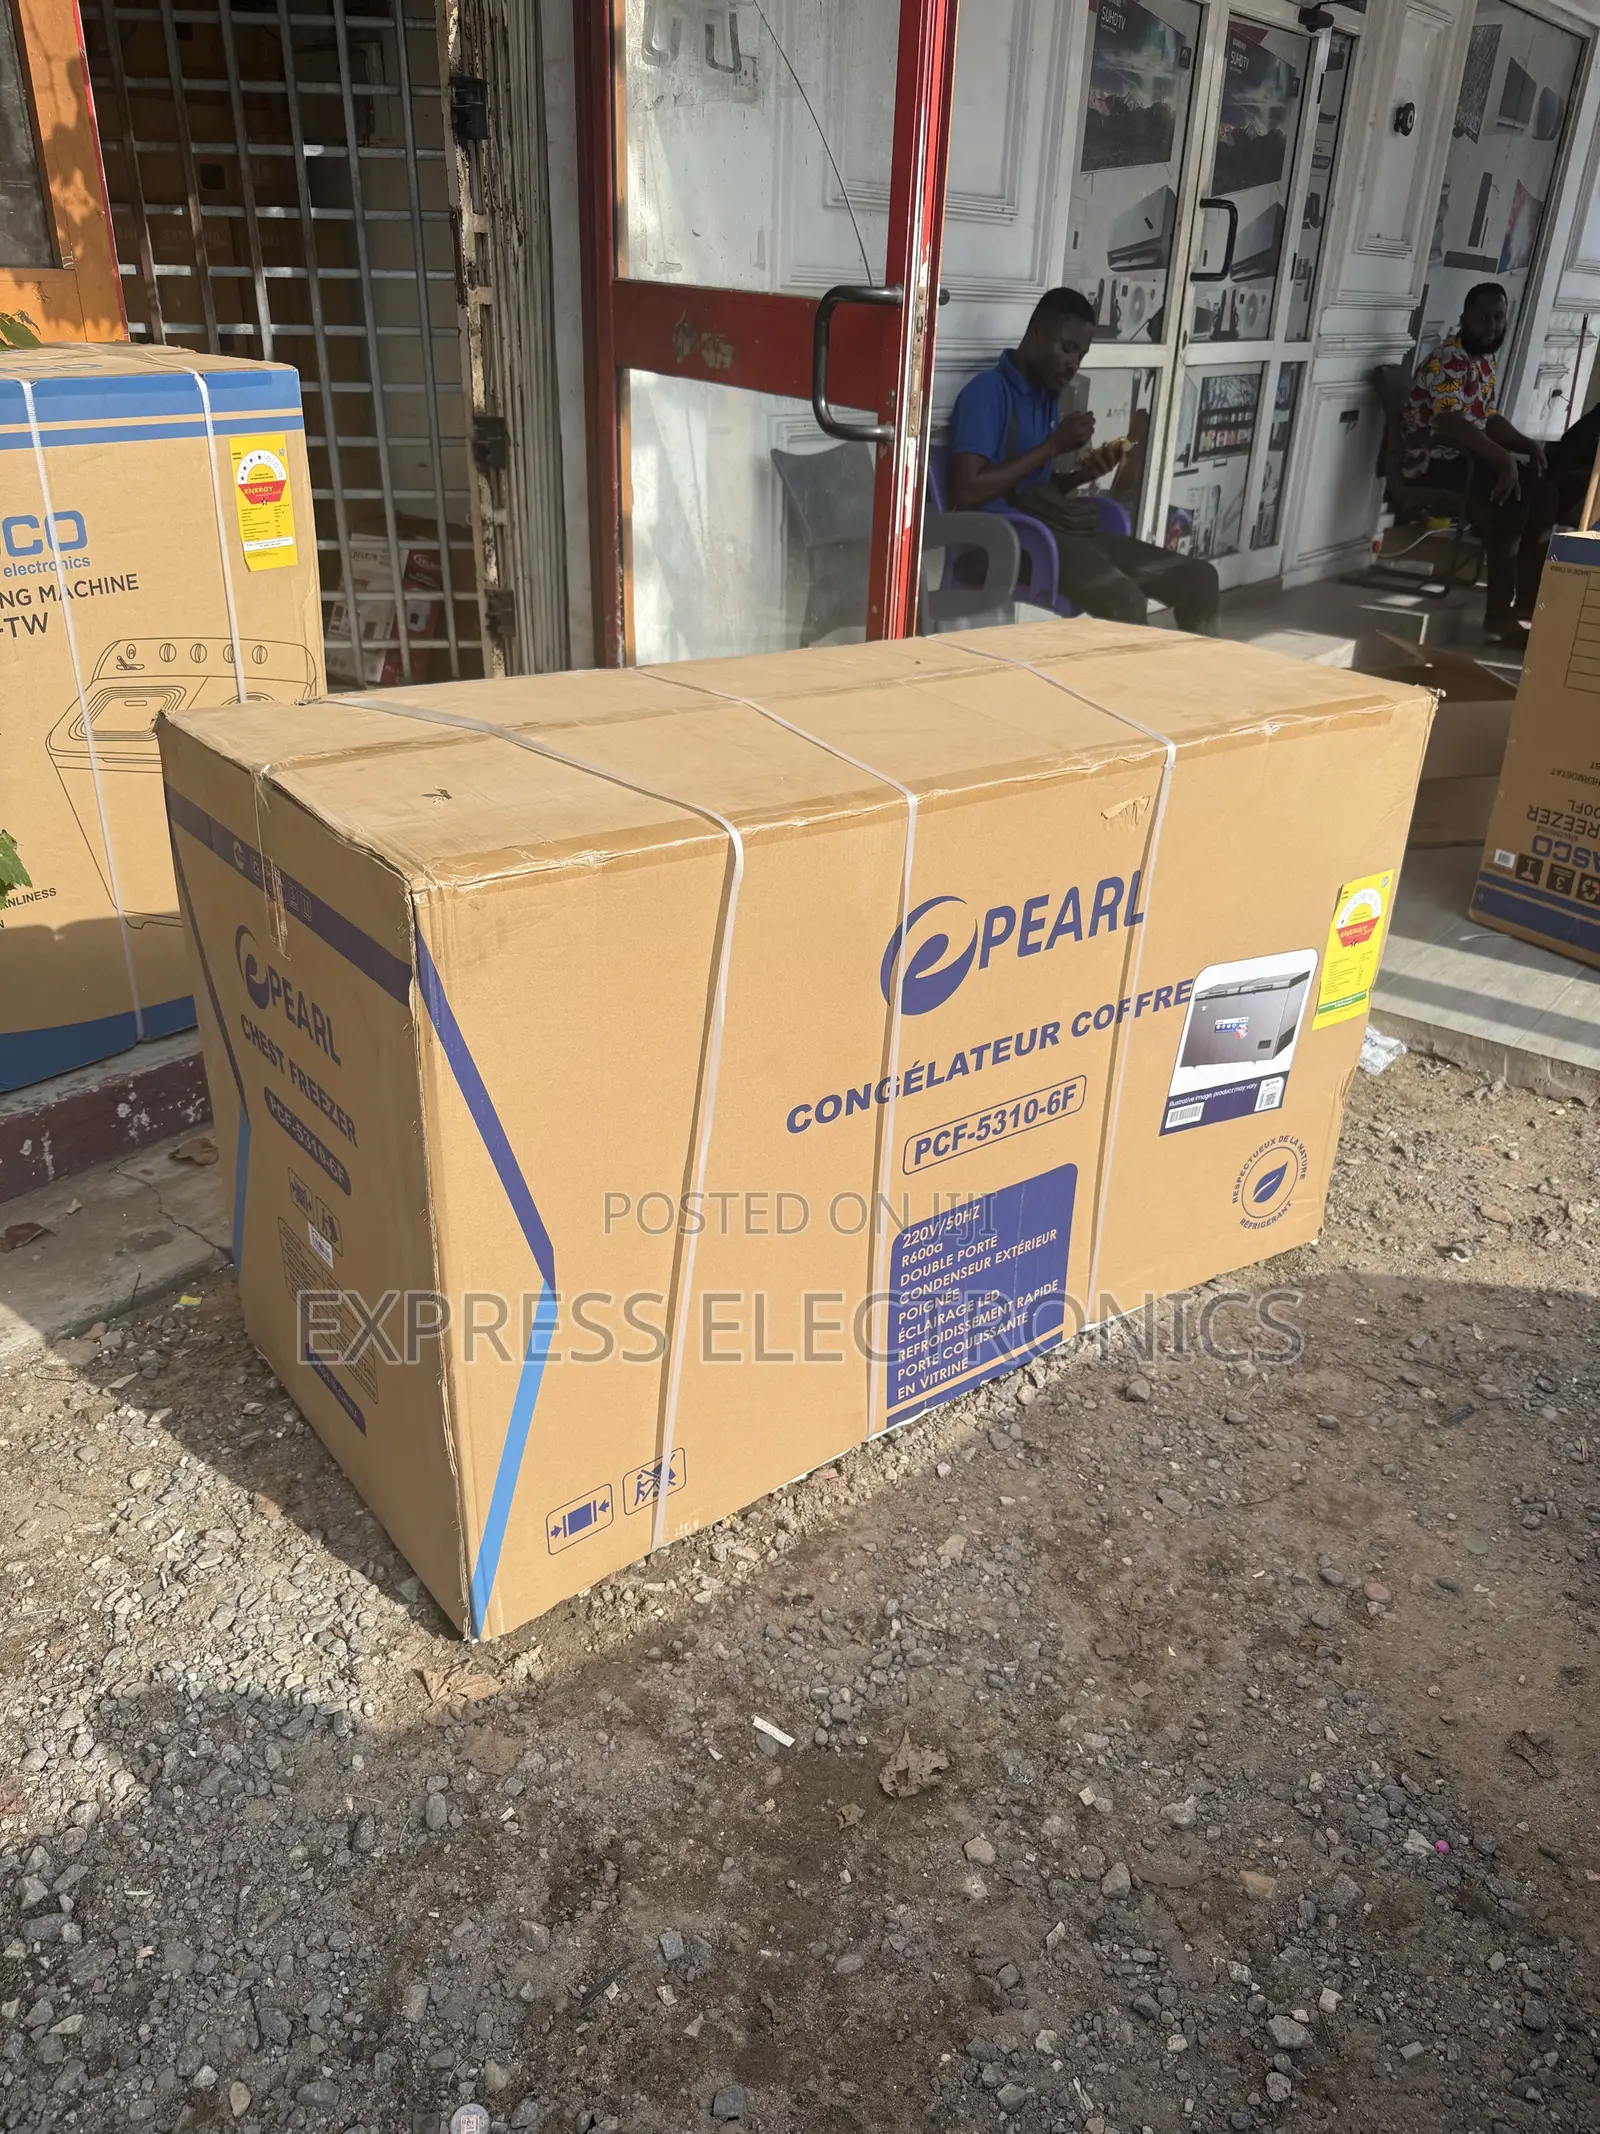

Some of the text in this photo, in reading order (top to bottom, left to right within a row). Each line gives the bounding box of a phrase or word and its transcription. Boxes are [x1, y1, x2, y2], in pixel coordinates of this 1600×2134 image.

[244, 486, 273, 495] ENERGY
[38, 573, 139, 604] MACHINE
[978, 870, 1144, 970] PEARL
[267, 963, 342, 1068] PEARL
[240, 1013, 358, 1149] CHEST FREEZER
[786, 979, 1193, 1134] CONGÉLATEUR COFFRE
[270, 1095, 345, 1182] PCF-5310-6F
[914, 1084, 1077, 1165] PCF-5310-6F
[1232, 1135, 1307, 1204] RESPECTUEUX DE LA NATURE
[900, 1235, 998, 1287] DOUBLE PORTE
[902, 1204, 980, 1249] 220V/50HZ
[902, 1242, 943, 1268] R600a
[899, 1228, 1057, 1305] CONDENSEUR EXTÉRIEUR
[898, 1287, 959, 1325] POIGNÉE
[898, 1289, 1000, 1344] ÉCLAIRAGE LED
[898, 1279, 1058, 1362] REFROIDISSEMENT RAPIDE
[898, 1352, 939, 1381] PORTE
[942, 1311, 1028, 1359] COULISSANTE
[898, 1357, 969, 1400] EN VITRINE
